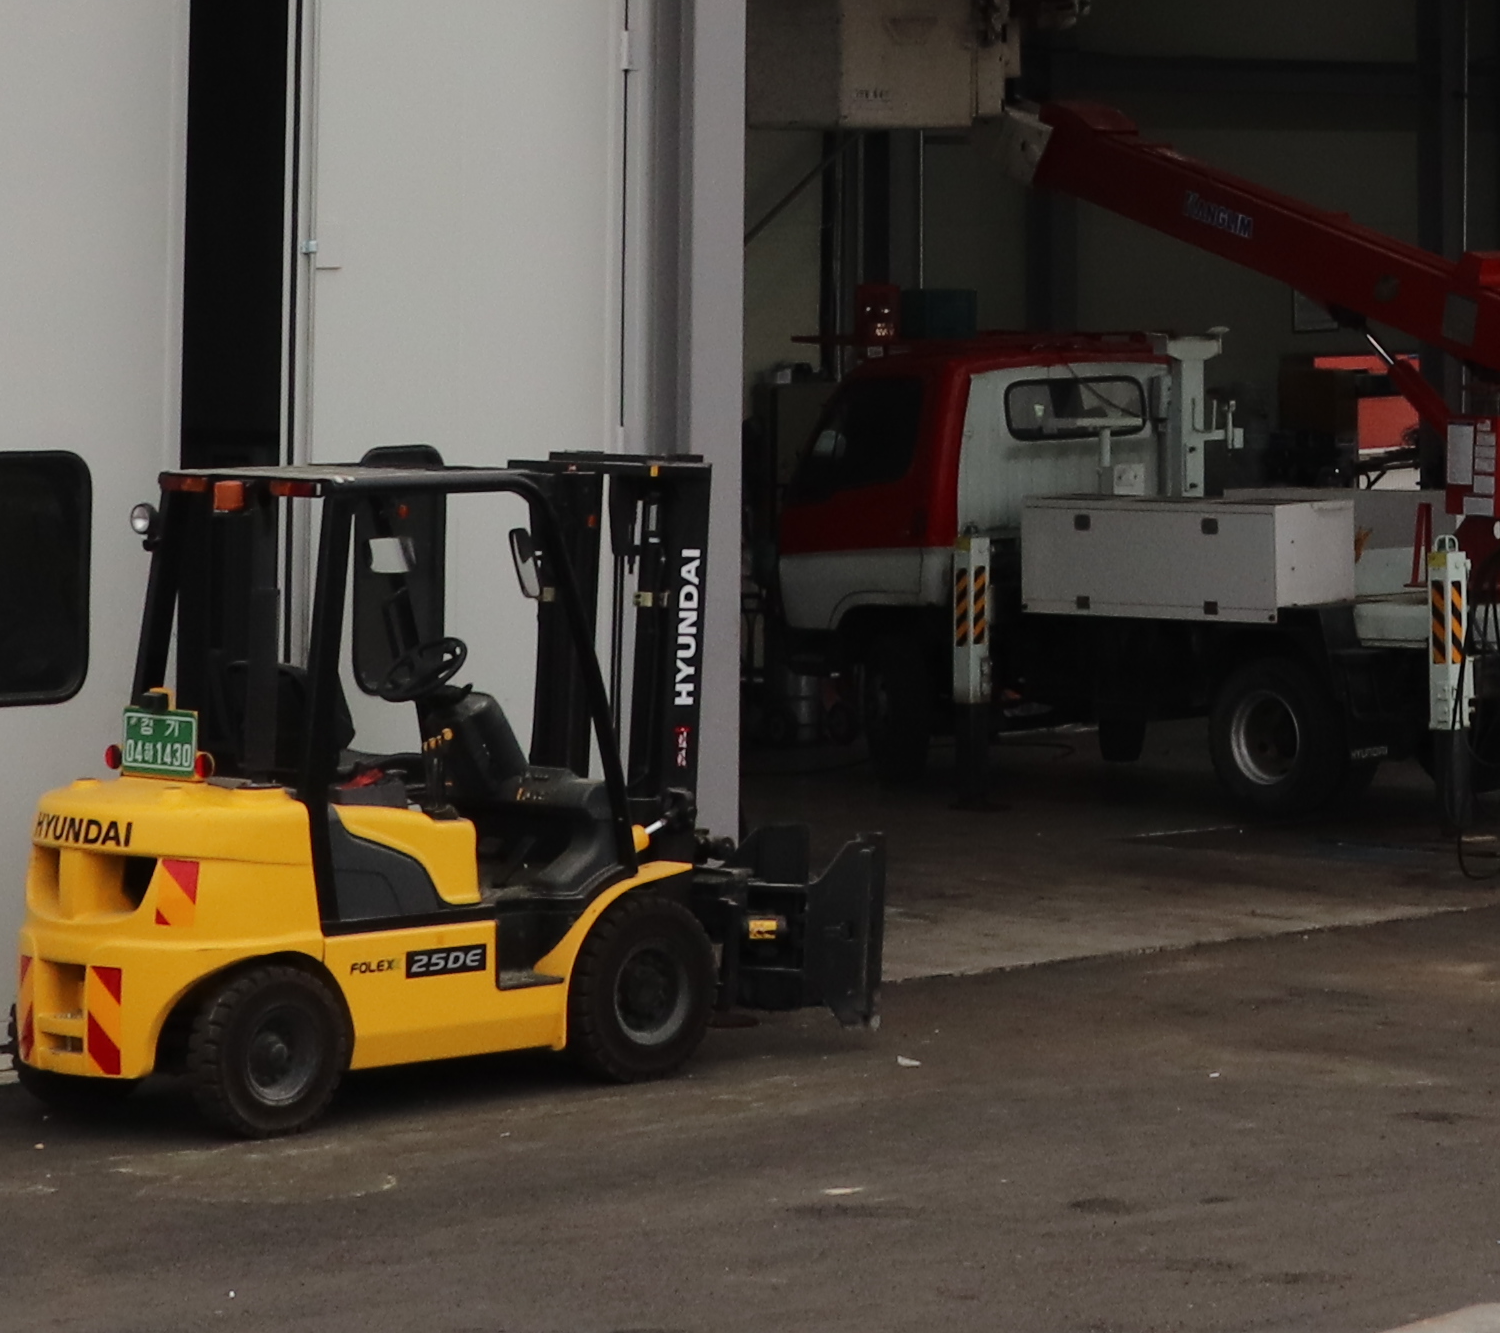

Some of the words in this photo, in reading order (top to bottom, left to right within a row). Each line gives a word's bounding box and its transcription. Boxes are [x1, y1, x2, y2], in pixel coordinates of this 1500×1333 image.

[674, 548, 701, 706] HYUNDAI
[35, 812, 133, 848] HYUNDAI
[410, 948, 483, 973] 25DE
